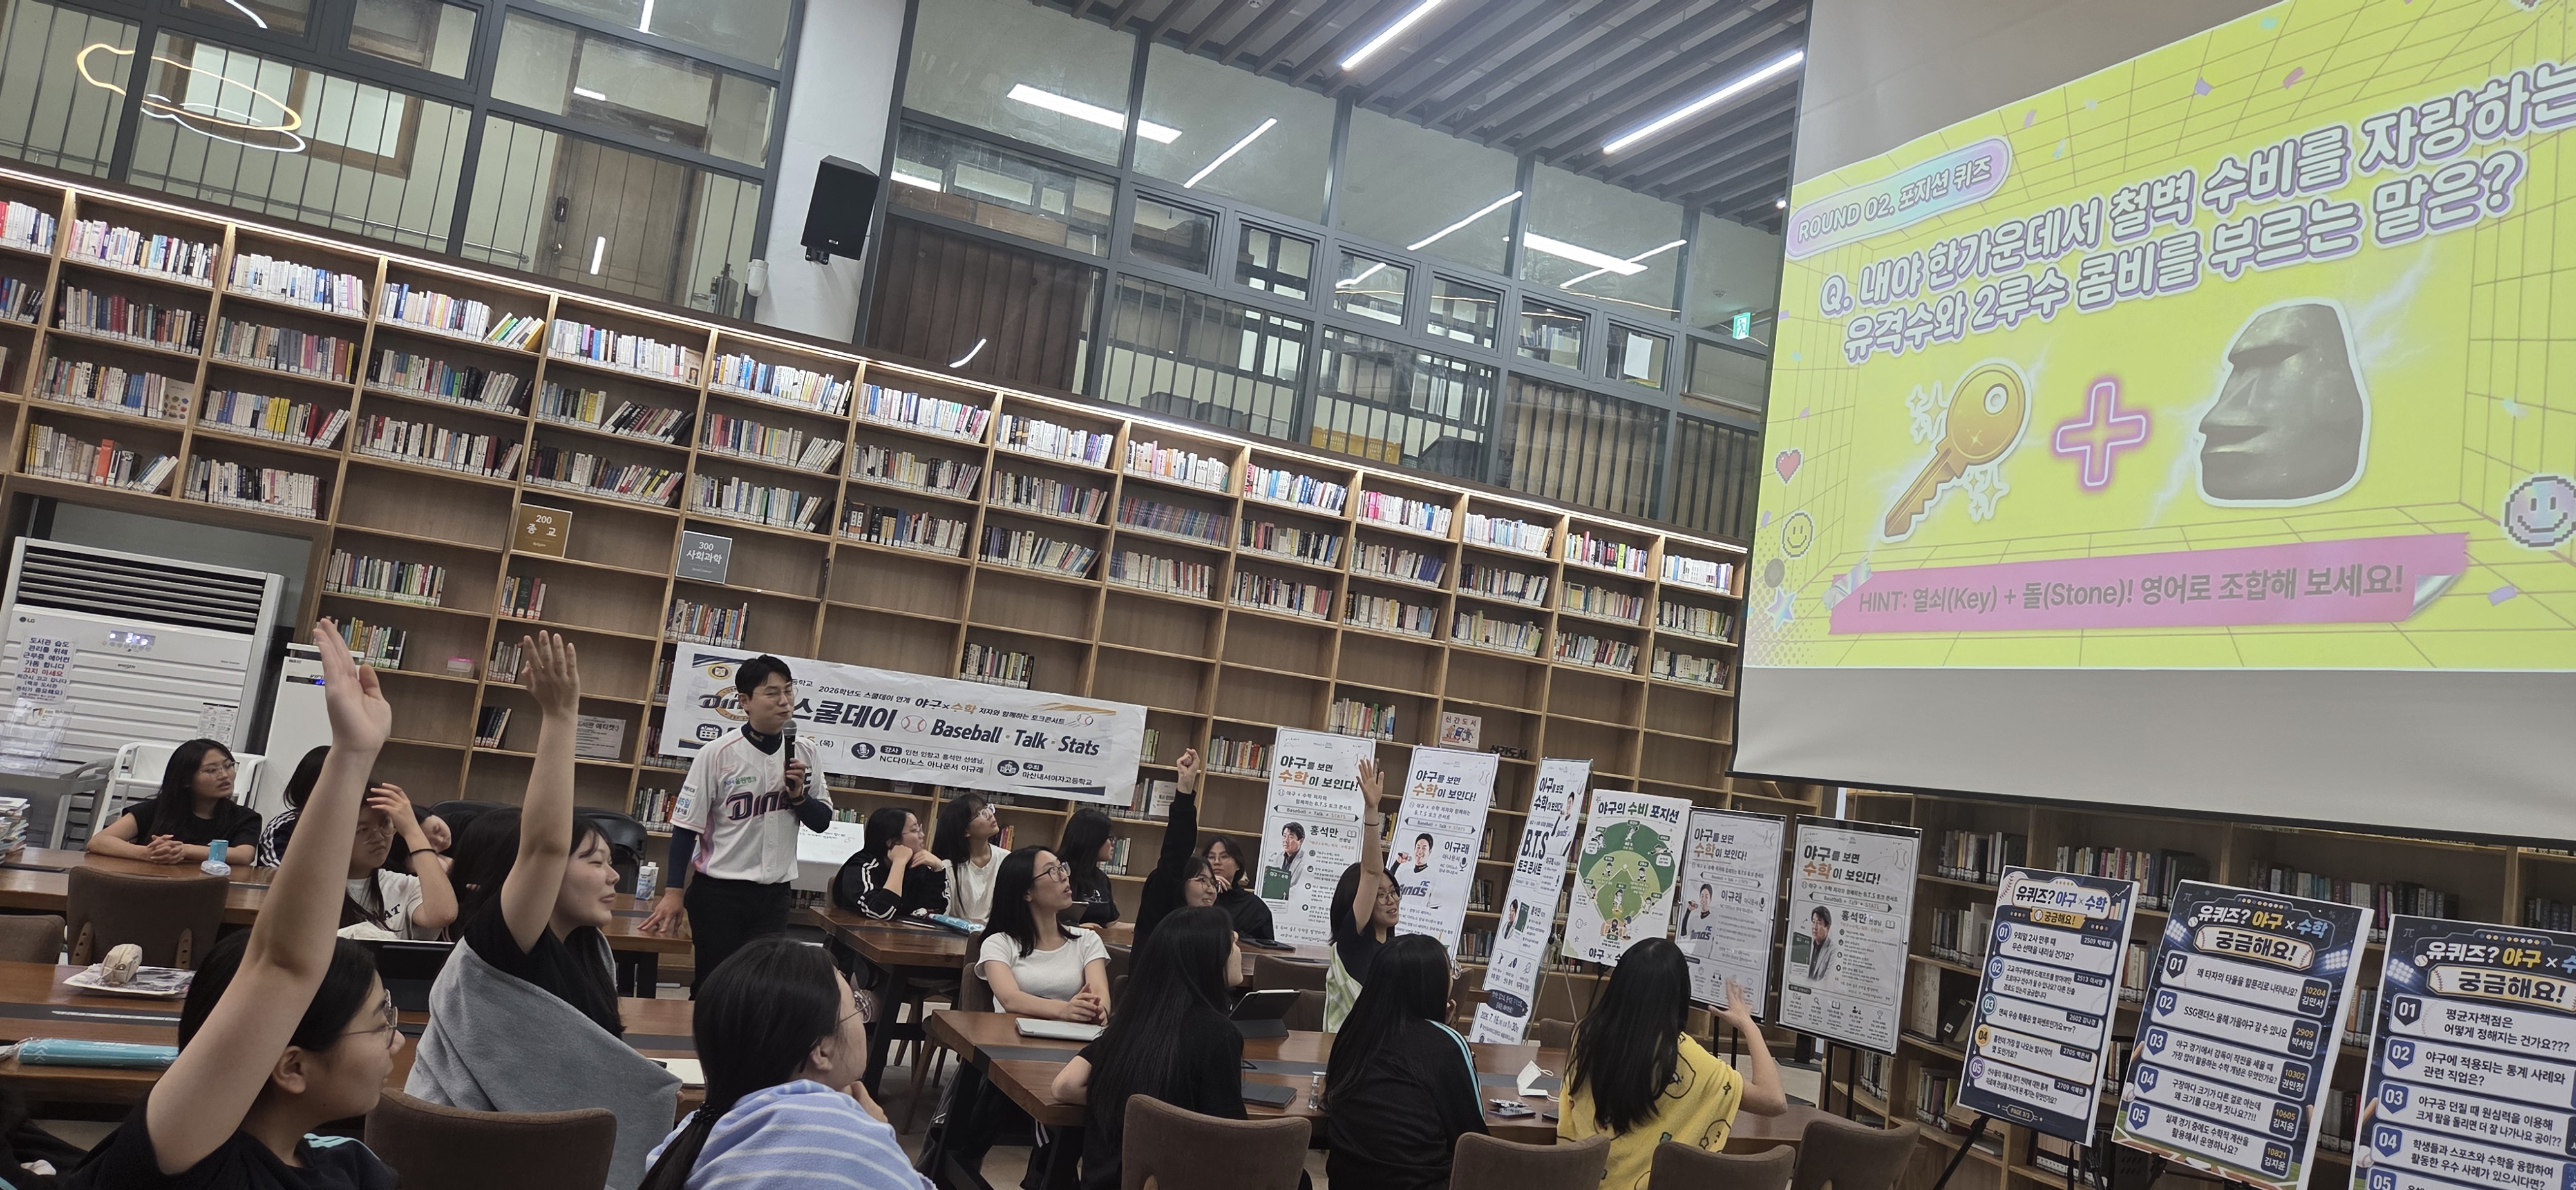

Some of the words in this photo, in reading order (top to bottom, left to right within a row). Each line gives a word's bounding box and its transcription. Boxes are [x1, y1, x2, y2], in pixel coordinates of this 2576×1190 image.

[1823, 277, 1852, 314] Q.
[1861, 252, 1923, 304] 내야
[1929, 197, 2101, 290] 한가운데서
[2112, 171, 2192, 238] 철벽
[2204, 125, 2347, 210] 수비를
[2360, 65, 2576, 169] 자랑하는
[1798, 204, 1861, 242] ROUND
[1865, 194, 1895, 220] 02.
[1899, 170, 1949, 209] 포지션
[1953, 156, 1992, 189] 퀴즈
[1845, 292, 1965, 359] 유격수와
[1973, 267, 2069, 327] 2루수
[2078, 231, 2200, 307] 콤비를
[2210, 200, 2360, 273] 부르는
[2373, 151, 2522, 243] 말은?
[536, 515, 552, 524] 200
[699, 542, 714, 551] 300
[687, 550, 722, 565] 사회과학
[1859, 591, 1907, 613] HINT:
[1912, 586, 1997, 614] 열쇠(Key)
[2022, 579, 2134, 610] 돌(Stone)!
[2141, 576, 2211, 604] 영어로
[2217, 570, 2297, 601] 조합해
[2305, 564, 2403, 598] 보세요!
[30, 638, 52, 646] 도서관
[48, 655, 70, 663] 에어컨
[819, 686, 861, 697] 2026학년도
[863, 692, 894, 702] 스쿨데이
[896, 695, 911, 704] 연계
[979, 708, 1001, 717] 저자와
[1002, 711, 1030, 721] 함께하는
[1030, 715, 1065, 725] 토크콘서트
[792, 698, 898, 732] 스쿨데이
[931, 719, 1003, 744] Baseball
[1014, 730, 1048, 750] Talk
[1058, 735, 1099, 756] Stats
[879, 755, 924, 767] NC다이노스
[927, 760, 958, 771] 아나운서
[961, 765, 984, 773] 이규래
[964, 756, 985, 765] 선생님,
[1280, 755, 1315, 770] 야구를
[1317, 763, 1333, 772] 보면
[1023, 772, 1092, 786] 마산내서여자고등학교
[1278, 770, 1319, 786] 수학이
[1321, 778, 1358, 791] 보인다!
[1416, 770, 1444, 783] 야구를
[1446, 776, 1461, 785] 보면
[1412, 783, 1446, 798] 수학이
[1448, 789, 1477, 802] 보인다!
[1598, 802, 1626, 815] 야구의
[1628, 802, 1649, 817] 수비
[1650, 805, 1680, 824] 포지션
[1310, 825, 1339, 838] 홍석만
[1444, 842, 1470, 855] 이규래
[1521, 829, 1549, 860] B.T.S
[1694, 842, 1722, 858] 수학이
[1723, 849, 1747, 861] 보인다!
[1804, 845, 1841, 862] 야구를
[1842, 853, 1860, 864] 보면
[1517, 860, 1528, 872] 토크
[1528, 862, 1542, 876] 콘서트
[1803, 861, 1842, 880] 수학이
[1845, 868, 1880, 885] 보인다!
[1721, 890, 1742, 904] 이규래
[2016, 886, 2055, 905] 유퀴즈?
[2056, 891, 2078, 907] 야구
[2085, 896, 2107, 912] 수학
[1841, 911, 1868, 923] 홍석만
[2045, 911, 2076, 925] 궁금해요!
[2198, 905, 2251, 925] 유퀴즈?
[2252, 911, 2284, 929] 야구
[2297, 919, 2328, 938] 수학
[2000, 927, 2007, 937] 01
[1589, 948, 1604, 959] 야구
[2216, 930, 2298, 962] 궁금해요!
[2426, 941, 2500, 963] 유퀴즈?
[2502, 948, 2542, 968] 야구
[2170, 958, 2183, 972] 01
[2305, 987, 2326, 996] 10204
[2458, 971, 2566, 1003] 궁금해요!
[2159, 995, 2173, 1010] 02
[2302, 996, 2324, 1008] 김민서
[2399, 1001, 2416, 1017] 01
[2184, 1006, 2215, 1021] SSG랜더스
[2216, 1013, 2229, 1025] 올해
[2230, 1016, 2254, 1030] 가을야구
[2270, 1026, 2287, 1038] 있나요
[2446, 1008, 2514, 1029] 평균자책점은
[2150, 1034, 2163, 1048] 03
[2295, 1028, 2314, 1038] 2909
[2444, 1024, 2474, 1038] 어떻게
[2477, 1029, 2517, 1044] 정해지는
[2521, 1035, 2570, 1052] 건가요???
[2291, 1037, 2313, 1050] 박서영
[2176, 1039, 2188, 1050] 야구
[2190, 1043, 2213, 1057] 경기에서
[2214, 1049, 2233, 1061] 감독이
[2234, 1054, 2251, 1067] 작전을
[2392, 1044, 2410, 1061] 02
[2285, 1069, 2306, 1081] 10302
[2423, 1066, 2445, 1079] 관련
[2447, 1070, 2485, 1086] 직업은?
[2426, 1051, 2458, 1067] 야구에
[2460, 1057, 2503, 1074] 적용되는
[2506, 1065, 2528, 1078] 통계
[2530, 1068, 2566, 1085] 사례와
[2140, 1071, 2154, 1086] 04
[2281, 1079, 2304, 1092] 권민정
[2172, 1079, 2197, 1094] 구장마다
[2197, 1085, 2216, 1098] 크기가
[2217, 1090, 2230, 1100] 다른
[2244, 1097, 2261, 1111] 아는데
[2385, 1089, 2403, 1106] 03
[2132, 1108, 2146, 1123] 05
[2275, 1109, 2296, 1120] 10605
[2418, 1096, 2447, 1111] 야구공
[2449, 1101, 2468, 1114] 던질
[2482, 1107, 2521, 1125] 원심력을
[2524, 1116, 2553, 1131] 이용해
[2272, 1119, 2295, 1133] 김지윤
[2416, 1111, 2432, 1121] 크게
[2452, 1117, 2477, 1131] 돌리면
[2500, 1125, 2532, 1142] 나가나요
[2534, 1133, 2562, 1147] 공이??
[2172, 1128, 2199, 1144] 활용해서
[2199, 1135, 2239, 1155] 운영하나요?
[2378, 1132, 2398, 1149] 04
[2267, 1147, 2286, 1159] 10821
[2413, 1138, 2448, 1155] 학생들과
[2449, 1148, 2485, 1164] 스포츠와
[2487, 1154, 2515, 1167] 수학을
[2517, 1160, 2553, 1178] 융합하여
[2264, 1157, 2286, 1171] 김지윤
[2410, 1153, 2439, 1168] 활동한
[2441, 1160, 2459, 1173] 우수
[2461, 1164, 2490, 1181] 사례가
[2492, 1170, 2546, 1190] 있으시다면?
[2373, 1175, 2391, 1190] 05
